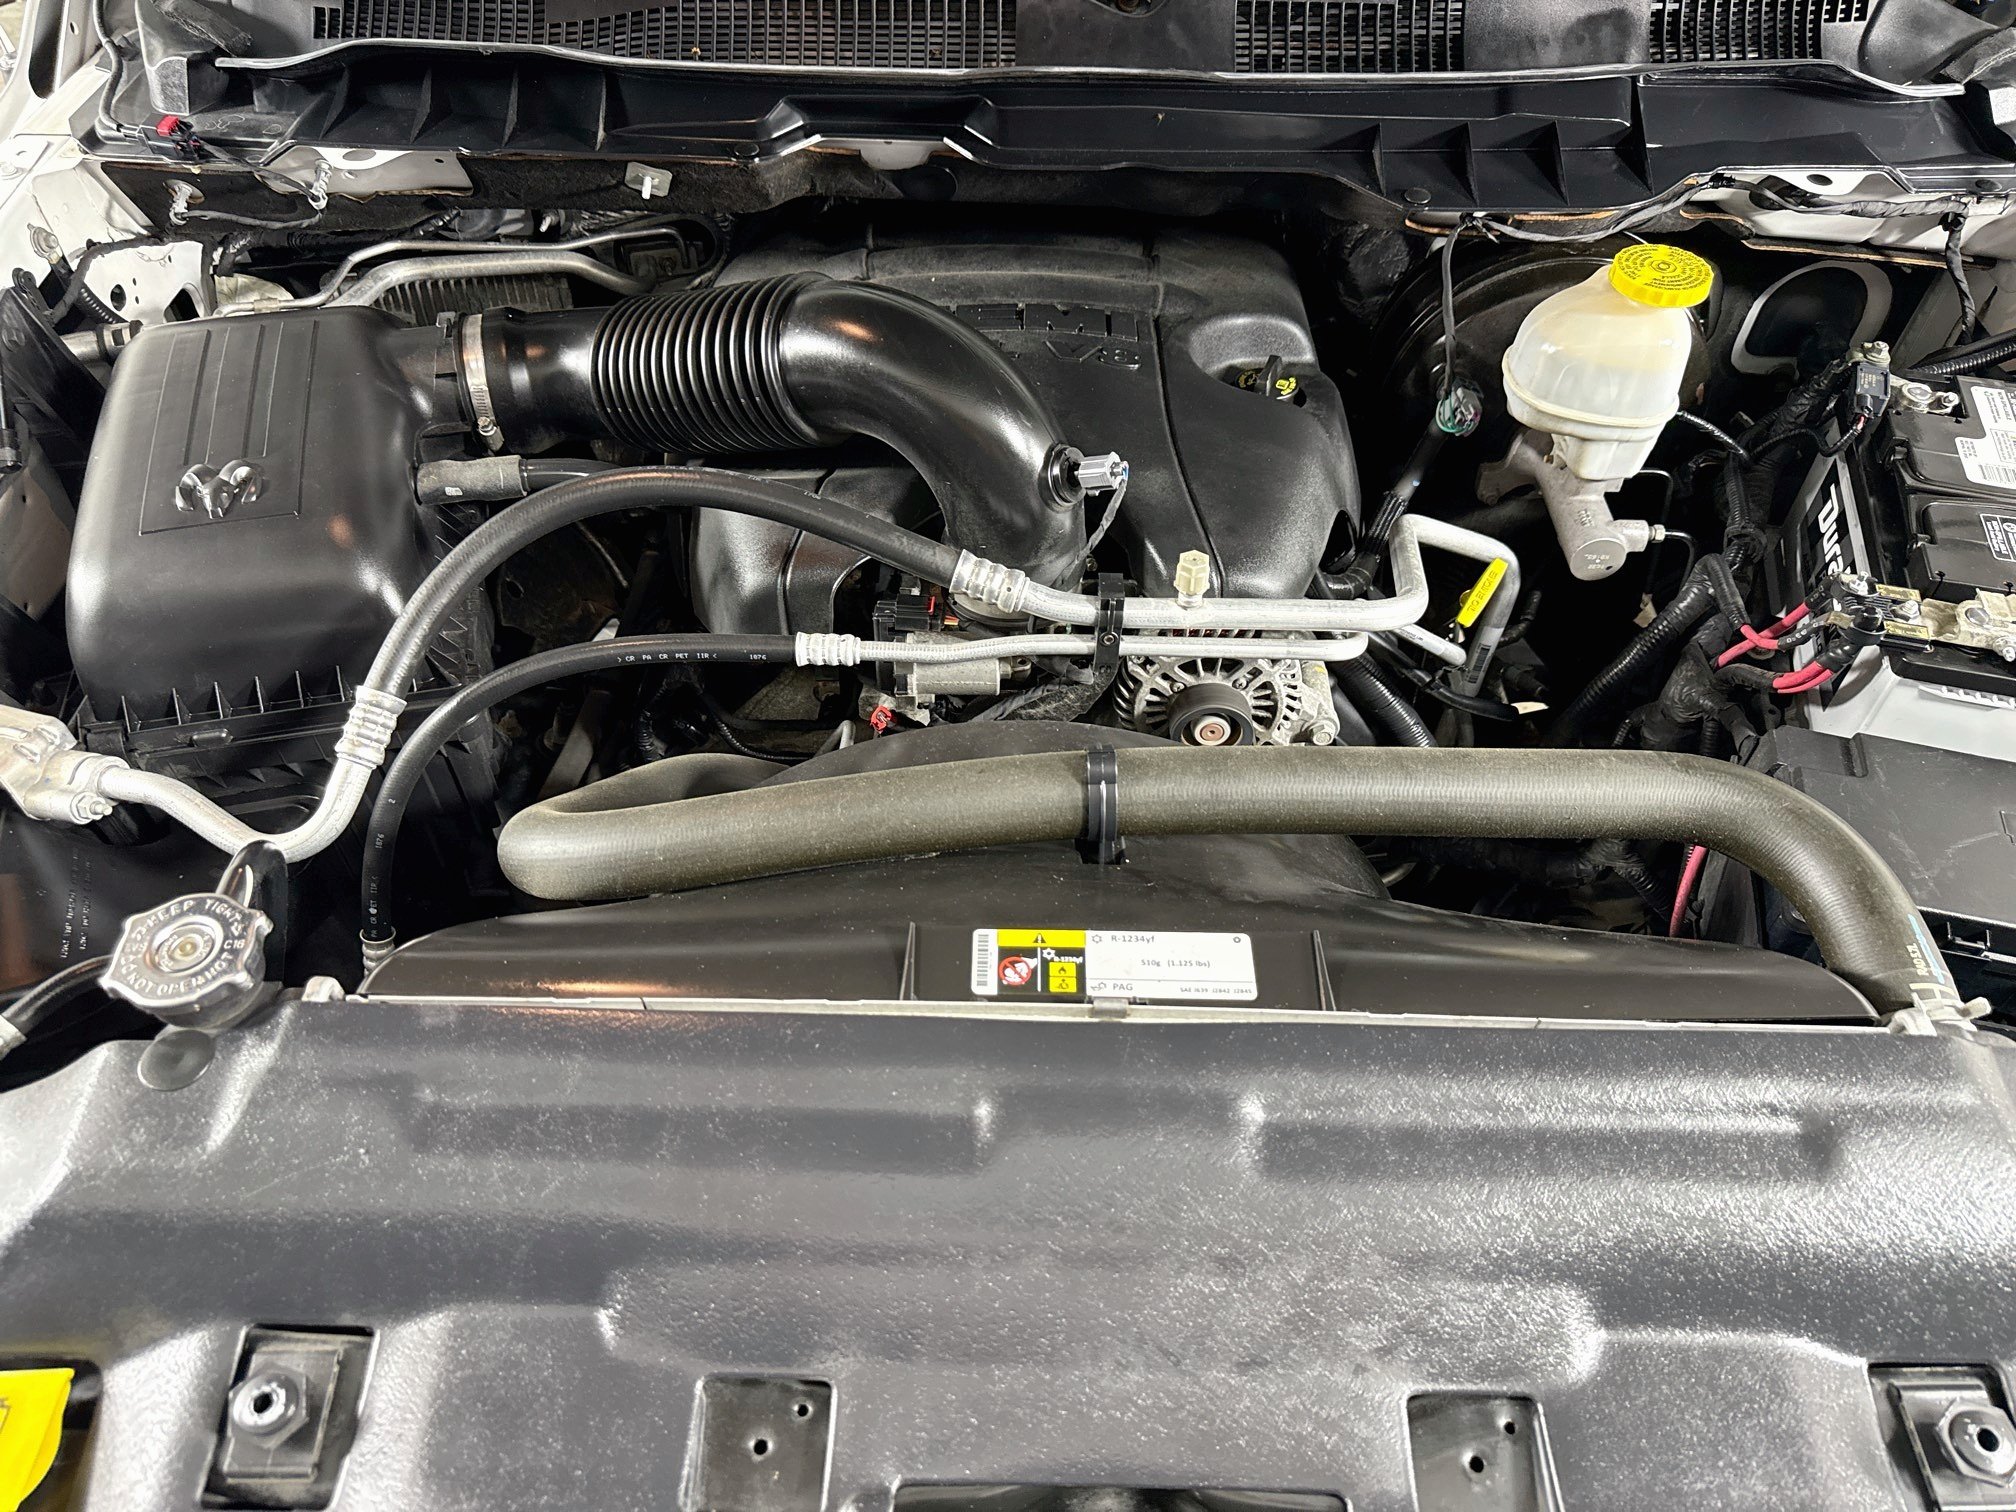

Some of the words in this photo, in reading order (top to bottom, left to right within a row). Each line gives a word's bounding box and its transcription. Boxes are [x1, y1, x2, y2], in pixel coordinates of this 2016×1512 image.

[944, 302, 1140, 343] EMI
[1818, 483, 1847, 578] Dura
[1111, 934, 1155, 944] R-1234yf
[1141, 959, 1161, 967] 510g
[1112, 983, 1134, 991] PAG
